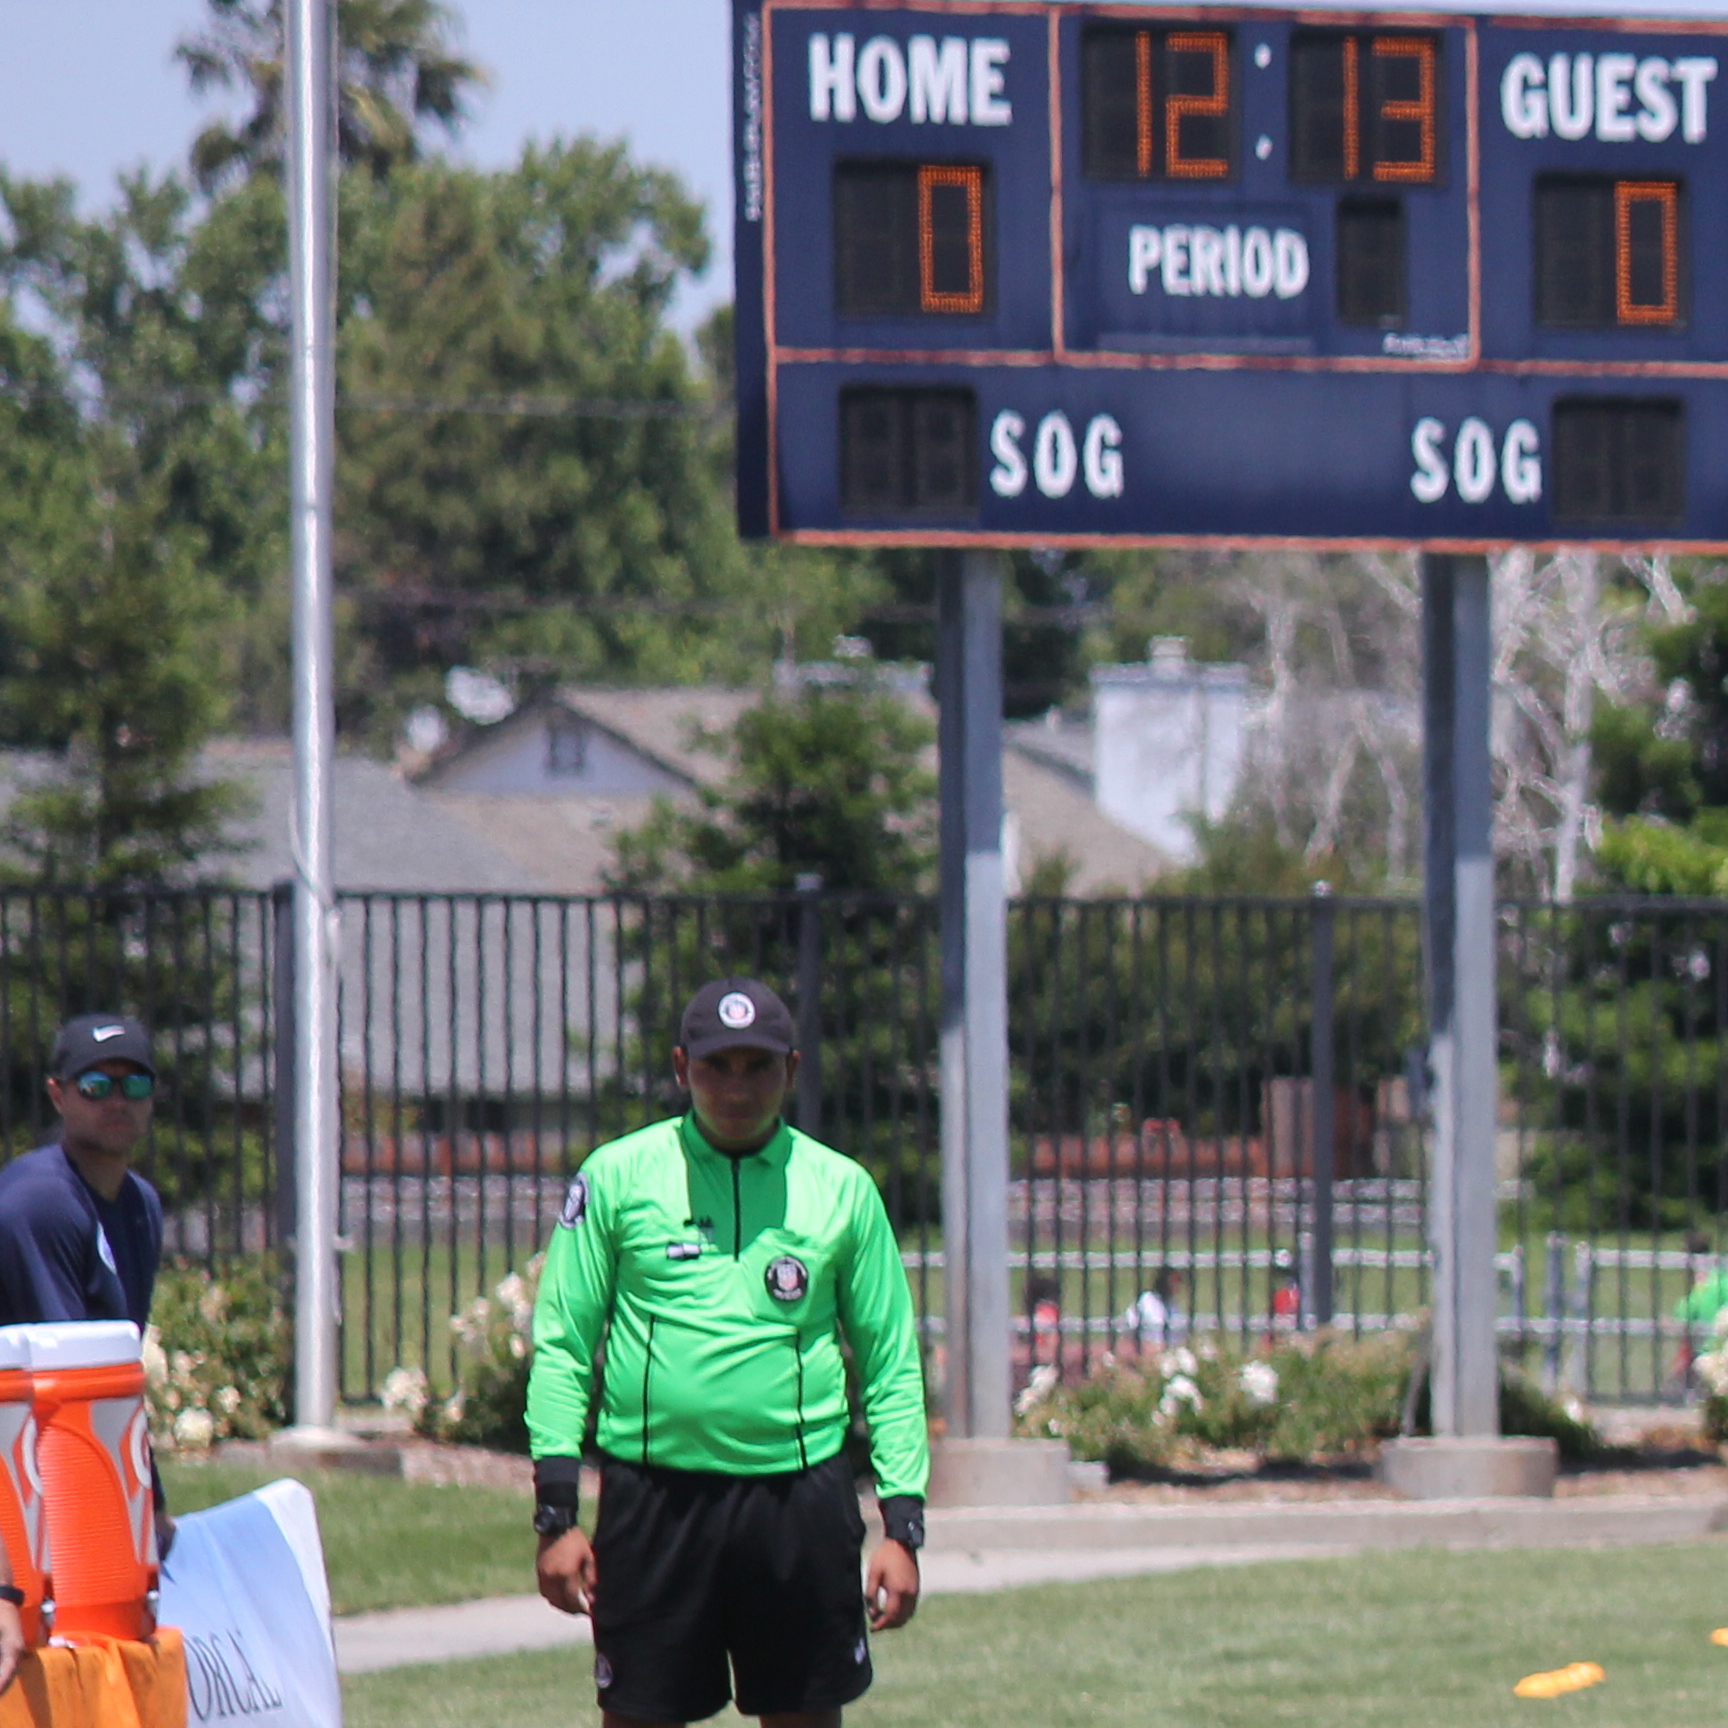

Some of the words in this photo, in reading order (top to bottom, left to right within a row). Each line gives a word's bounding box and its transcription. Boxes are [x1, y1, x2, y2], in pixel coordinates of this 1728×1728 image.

[808, 32, 1012, 127] HOME
[1500, 52, 1718, 144] GUEST
[917, 164, 985, 314] 0
[1127, 224, 1310, 300] PERIOD
[1613, 180, 1679, 326] 0
[989, 410, 1125, 500] SOG
[1409, 416, 1542, 504] SOG
